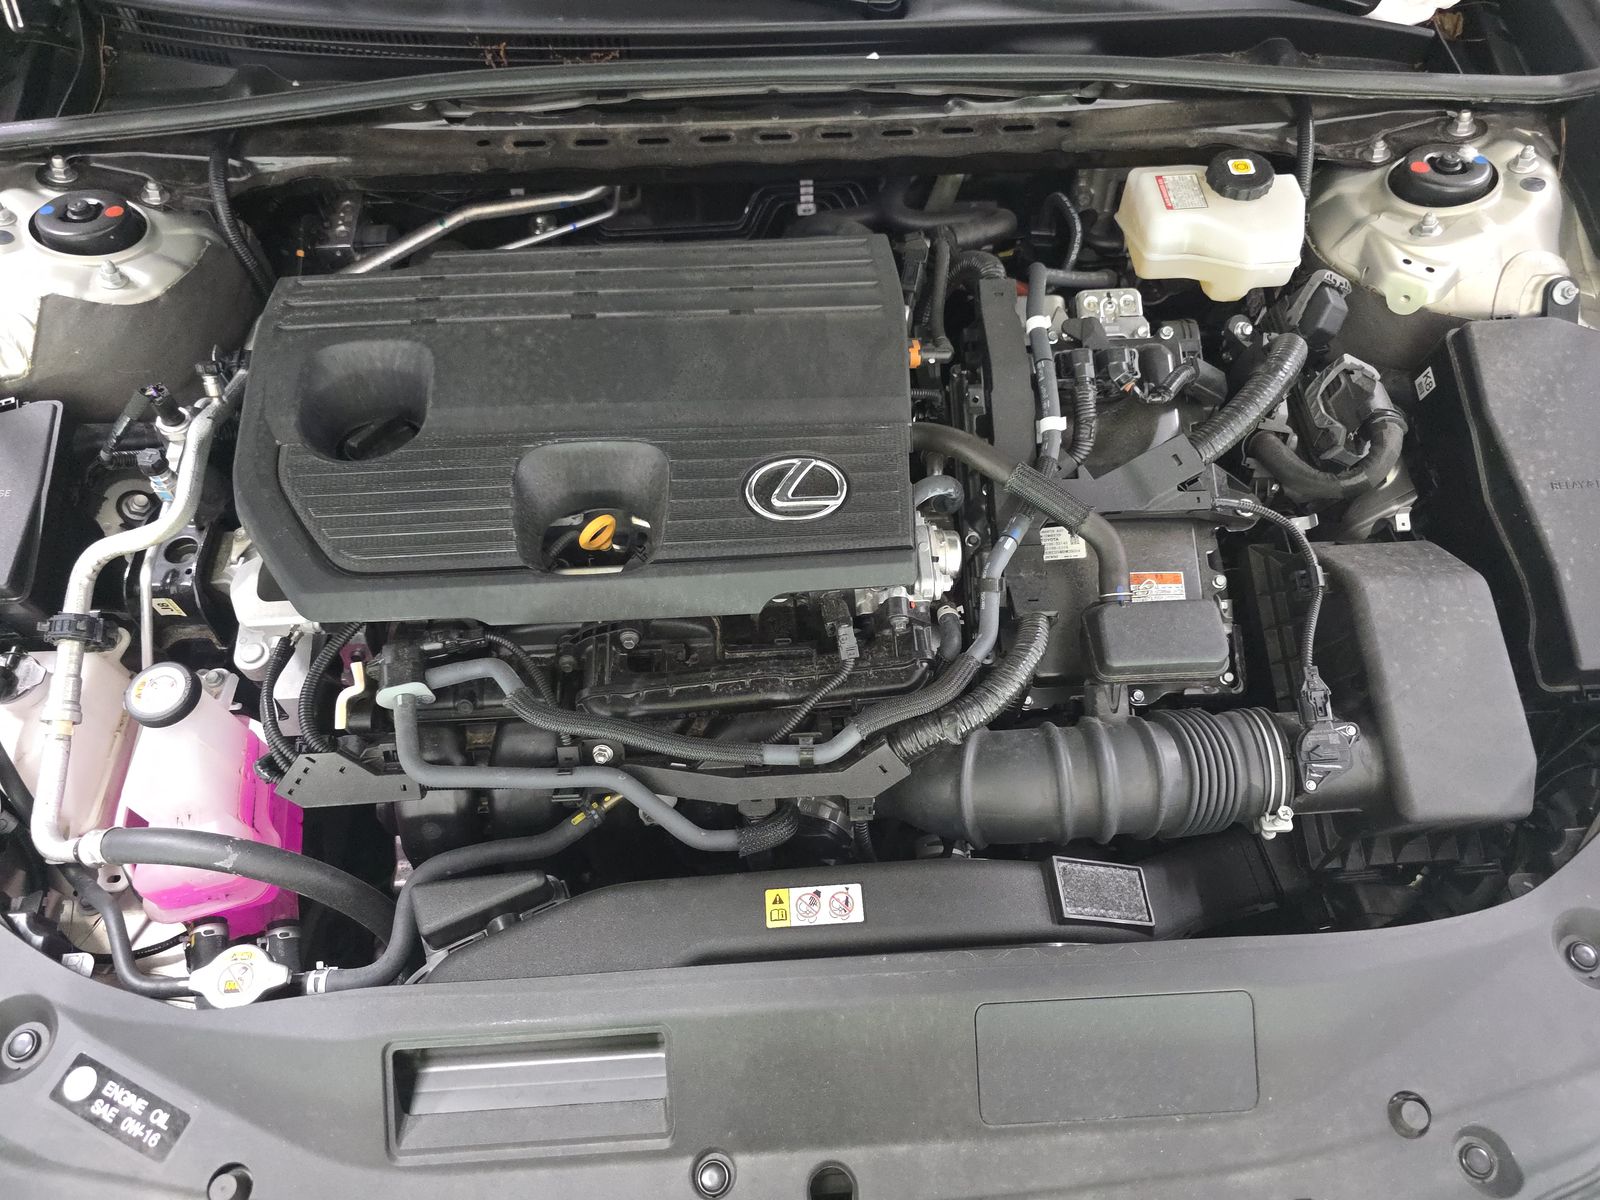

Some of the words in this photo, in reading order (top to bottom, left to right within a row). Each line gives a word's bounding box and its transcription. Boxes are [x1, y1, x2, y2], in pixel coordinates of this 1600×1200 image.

[1422, 371, 1433, 392] K8
[90, 1098, 120, 1124] SAE
[120, 1116, 161, 1148] 0W-16
[101, 1080, 149, 1116] ENGINE
[149, 1108, 171, 1131] OIL
